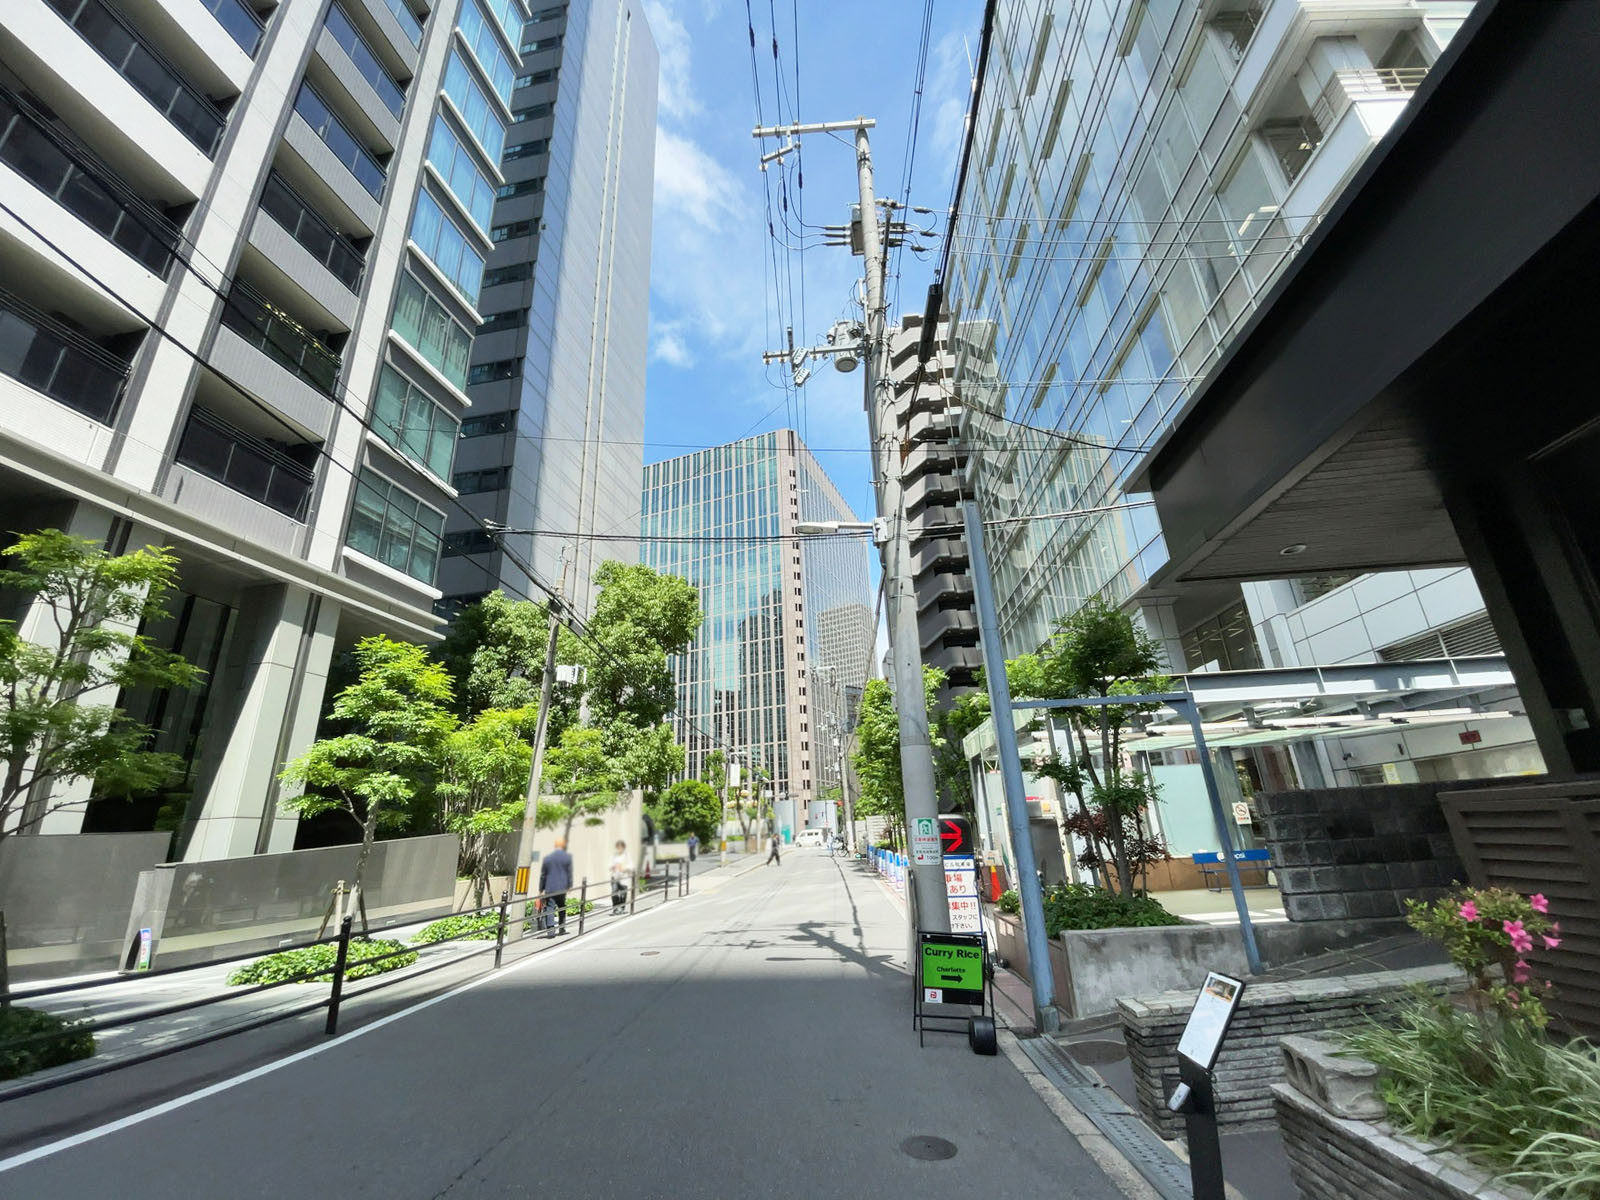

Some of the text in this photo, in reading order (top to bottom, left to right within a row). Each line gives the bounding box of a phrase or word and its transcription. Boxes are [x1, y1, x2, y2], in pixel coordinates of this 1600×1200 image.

[947, 901, 976, 911] 集中!!
[925, 947, 980, 959] Curry Rice
